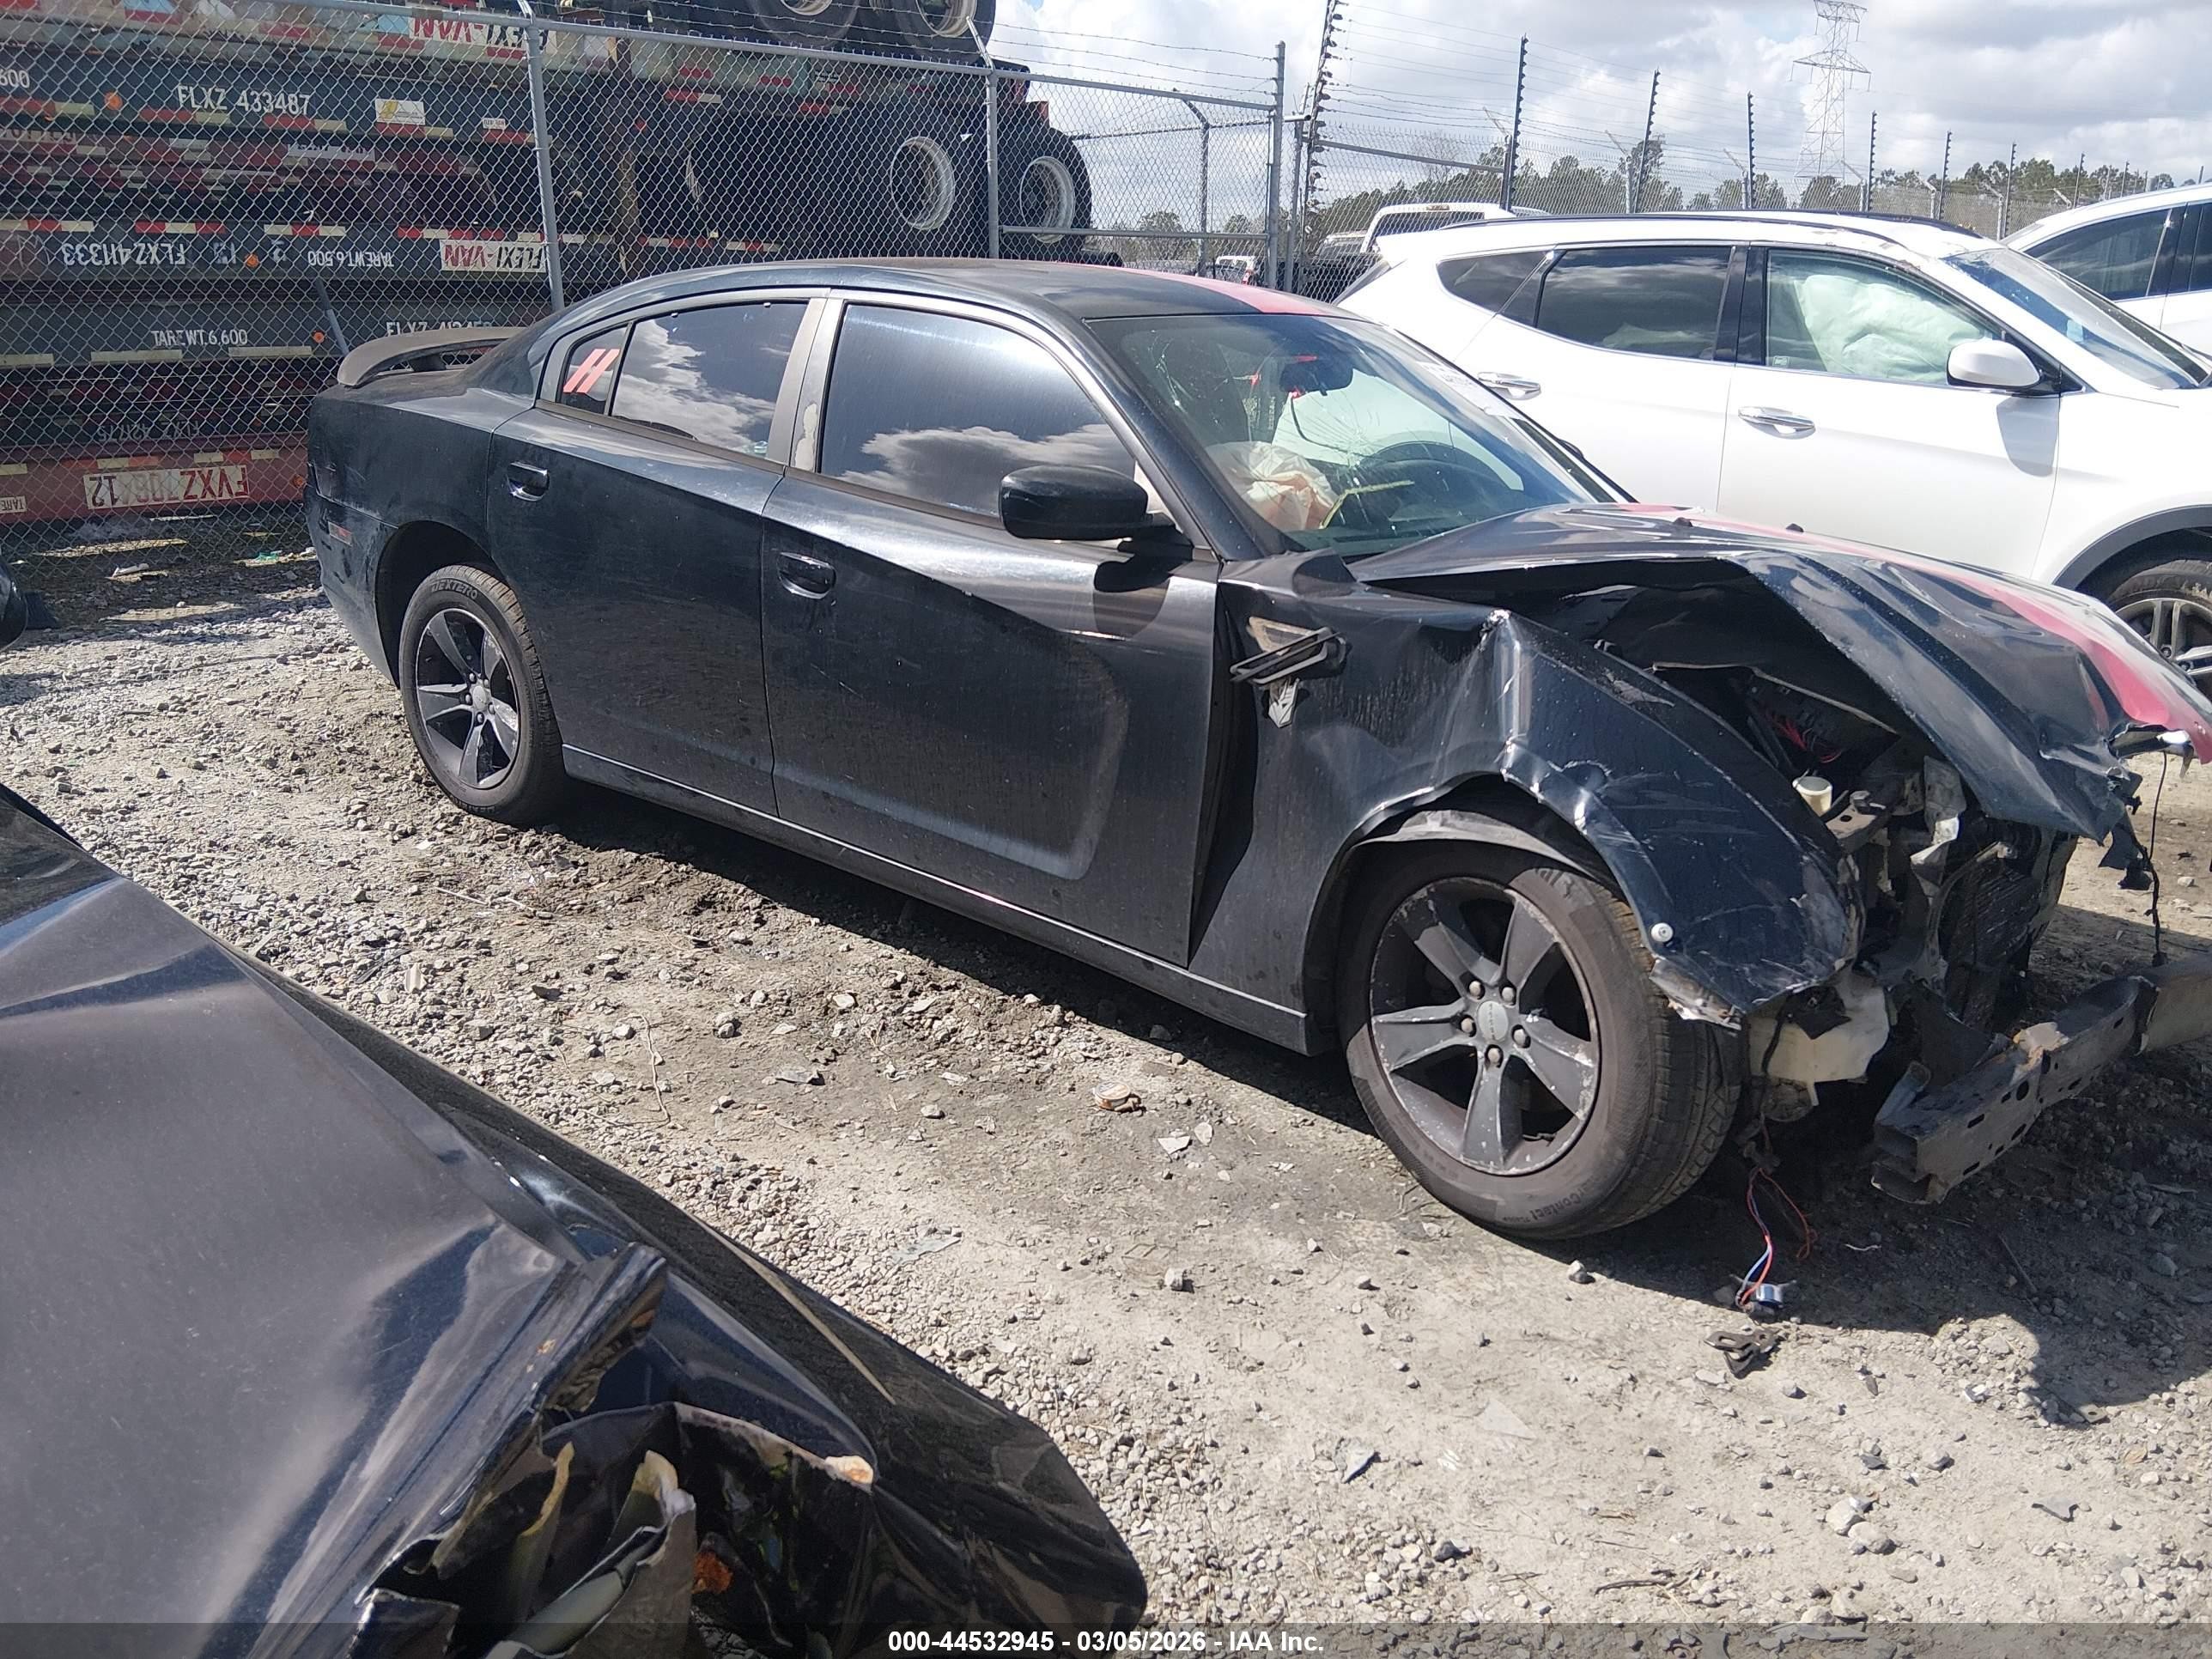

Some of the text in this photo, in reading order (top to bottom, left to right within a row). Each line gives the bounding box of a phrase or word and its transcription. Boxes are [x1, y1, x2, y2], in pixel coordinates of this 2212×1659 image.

[178, 85, 310, 115] FLXZ 433487
[134, 242, 186, 265] FLXZ
[444, 245, 543, 270] FLEXI-VAN
[179, 467, 249, 499] FVXZ
